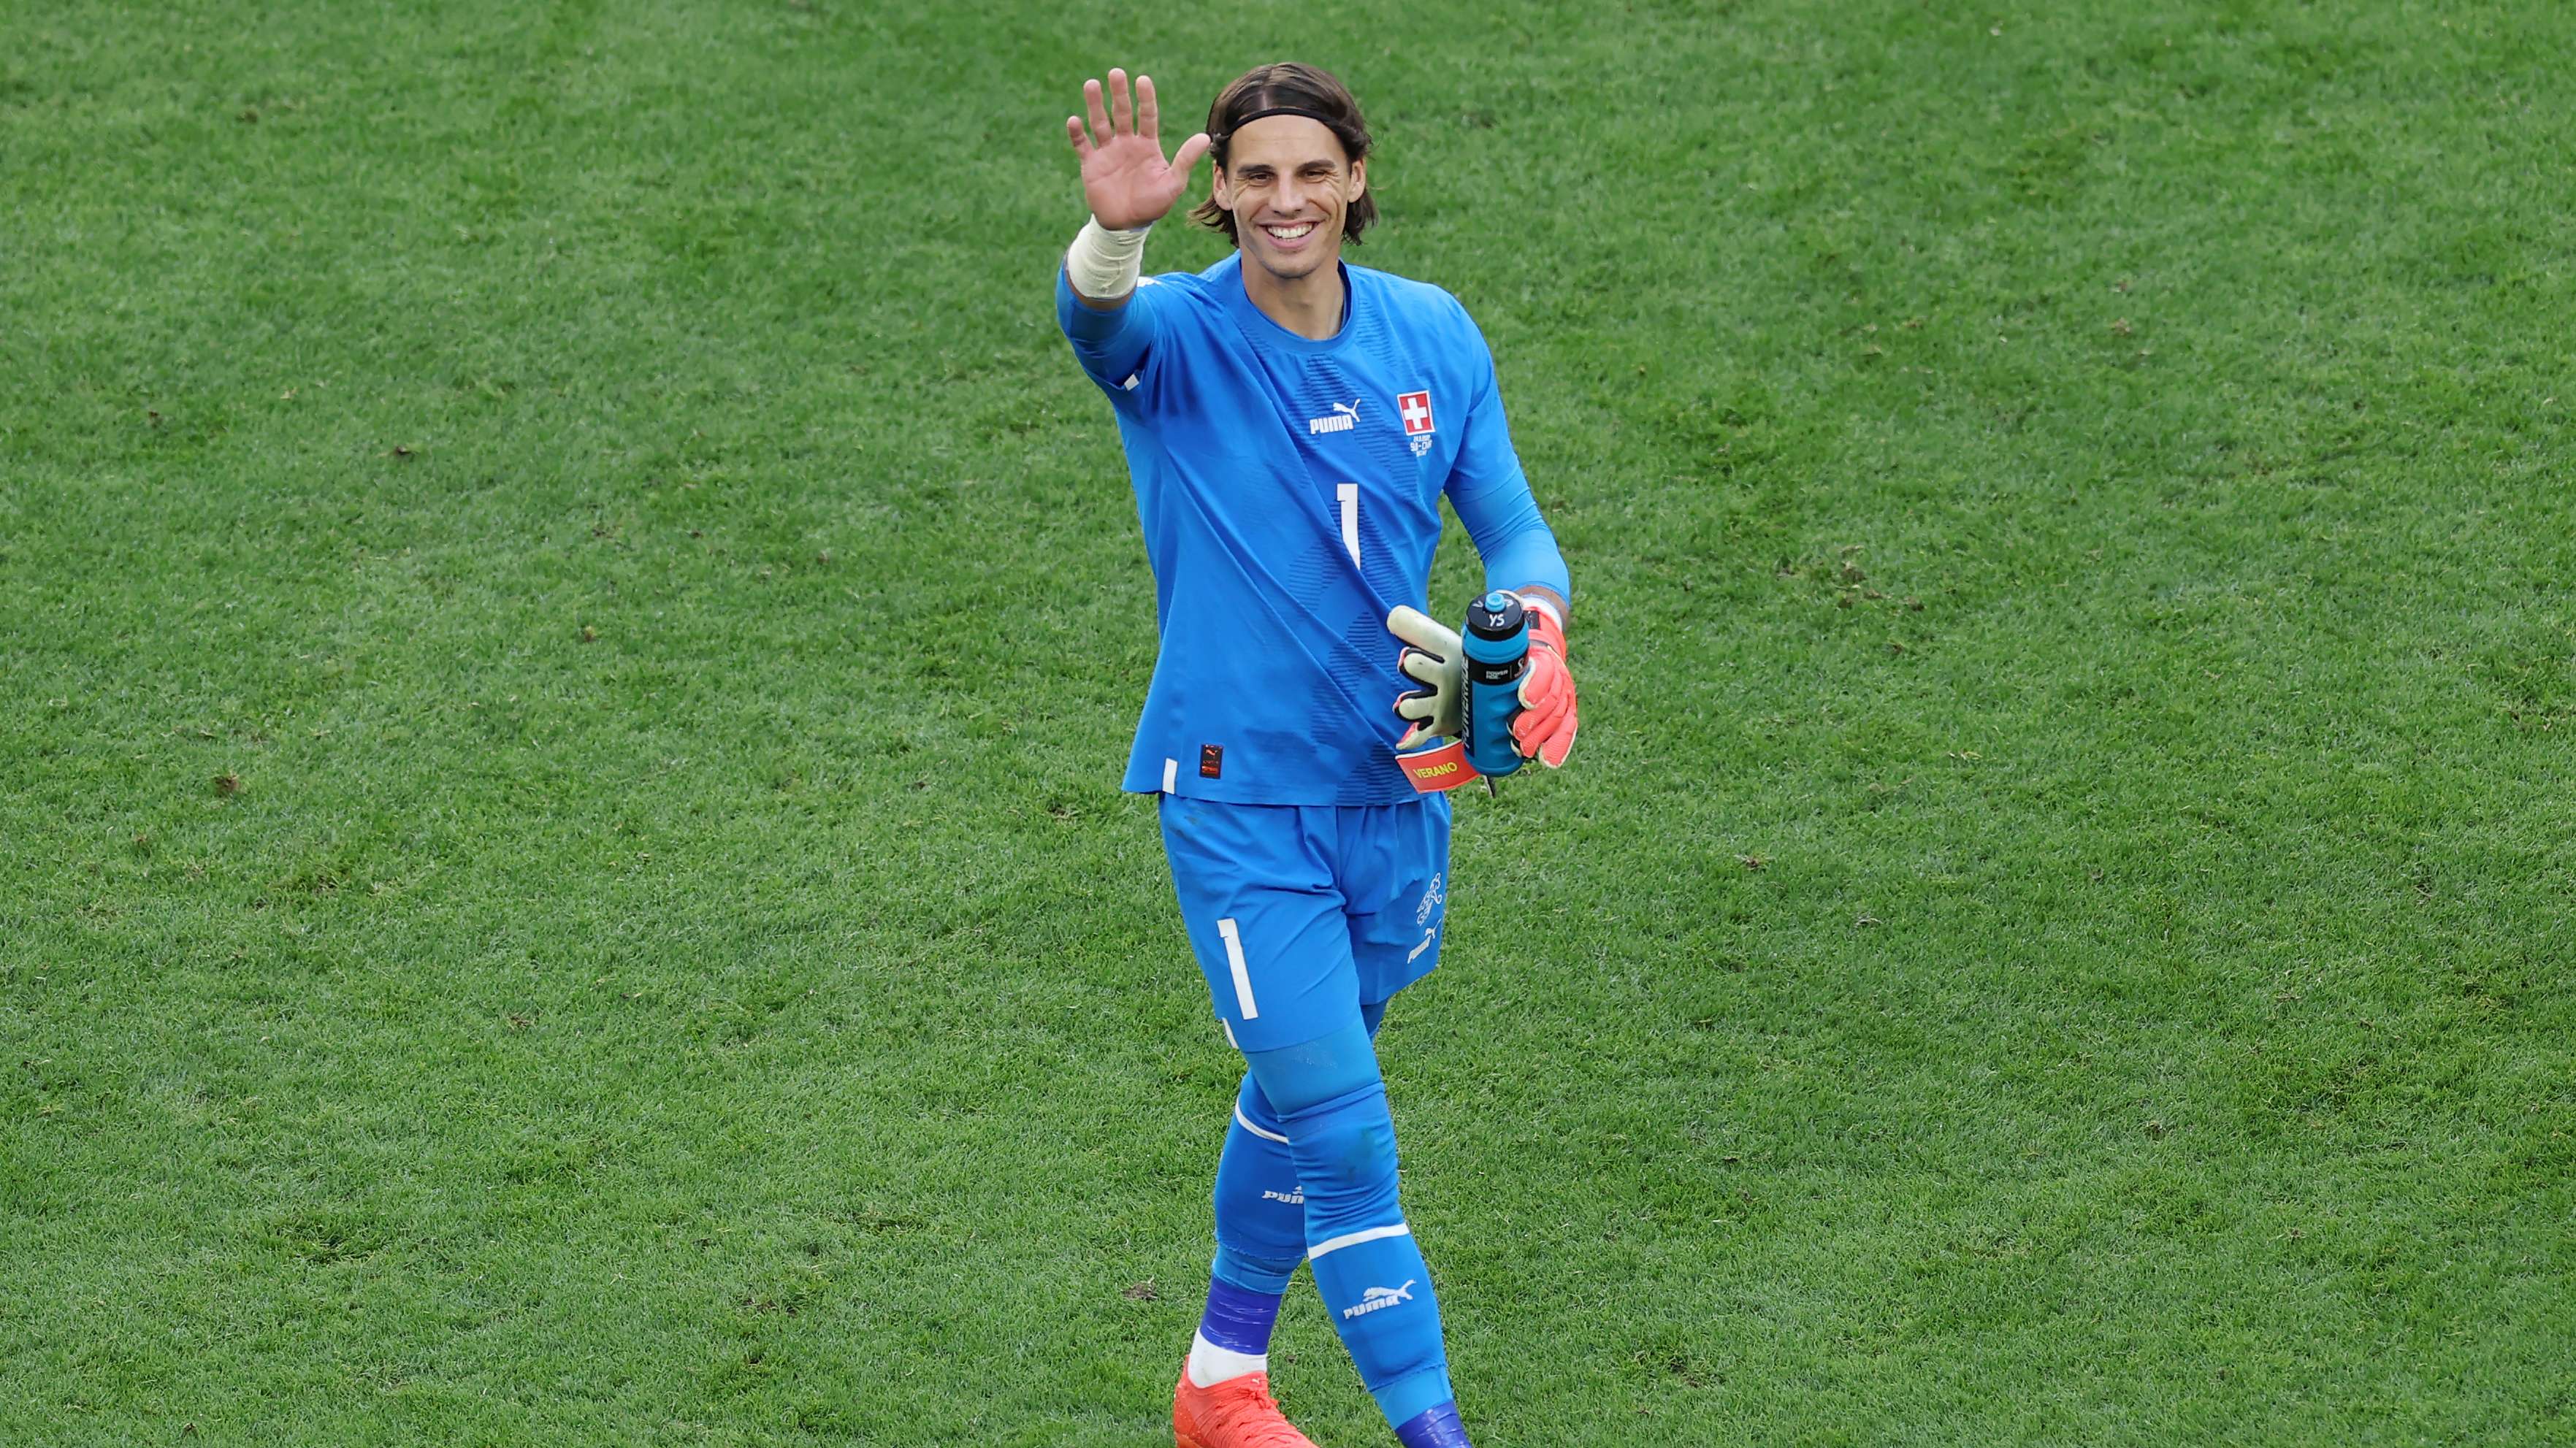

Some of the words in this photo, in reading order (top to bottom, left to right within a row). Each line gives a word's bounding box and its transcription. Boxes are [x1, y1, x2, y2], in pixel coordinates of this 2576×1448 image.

[1310, 414, 1353, 434] PUMA
[1337, 483, 1360, 570] 1
[1413, 762, 1458, 778] VERANO
[1217, 918, 1258, 1020] 1
[1262, 1190, 1304, 1204] PUM
[1343, 1295, 1401, 1319] PUMA
